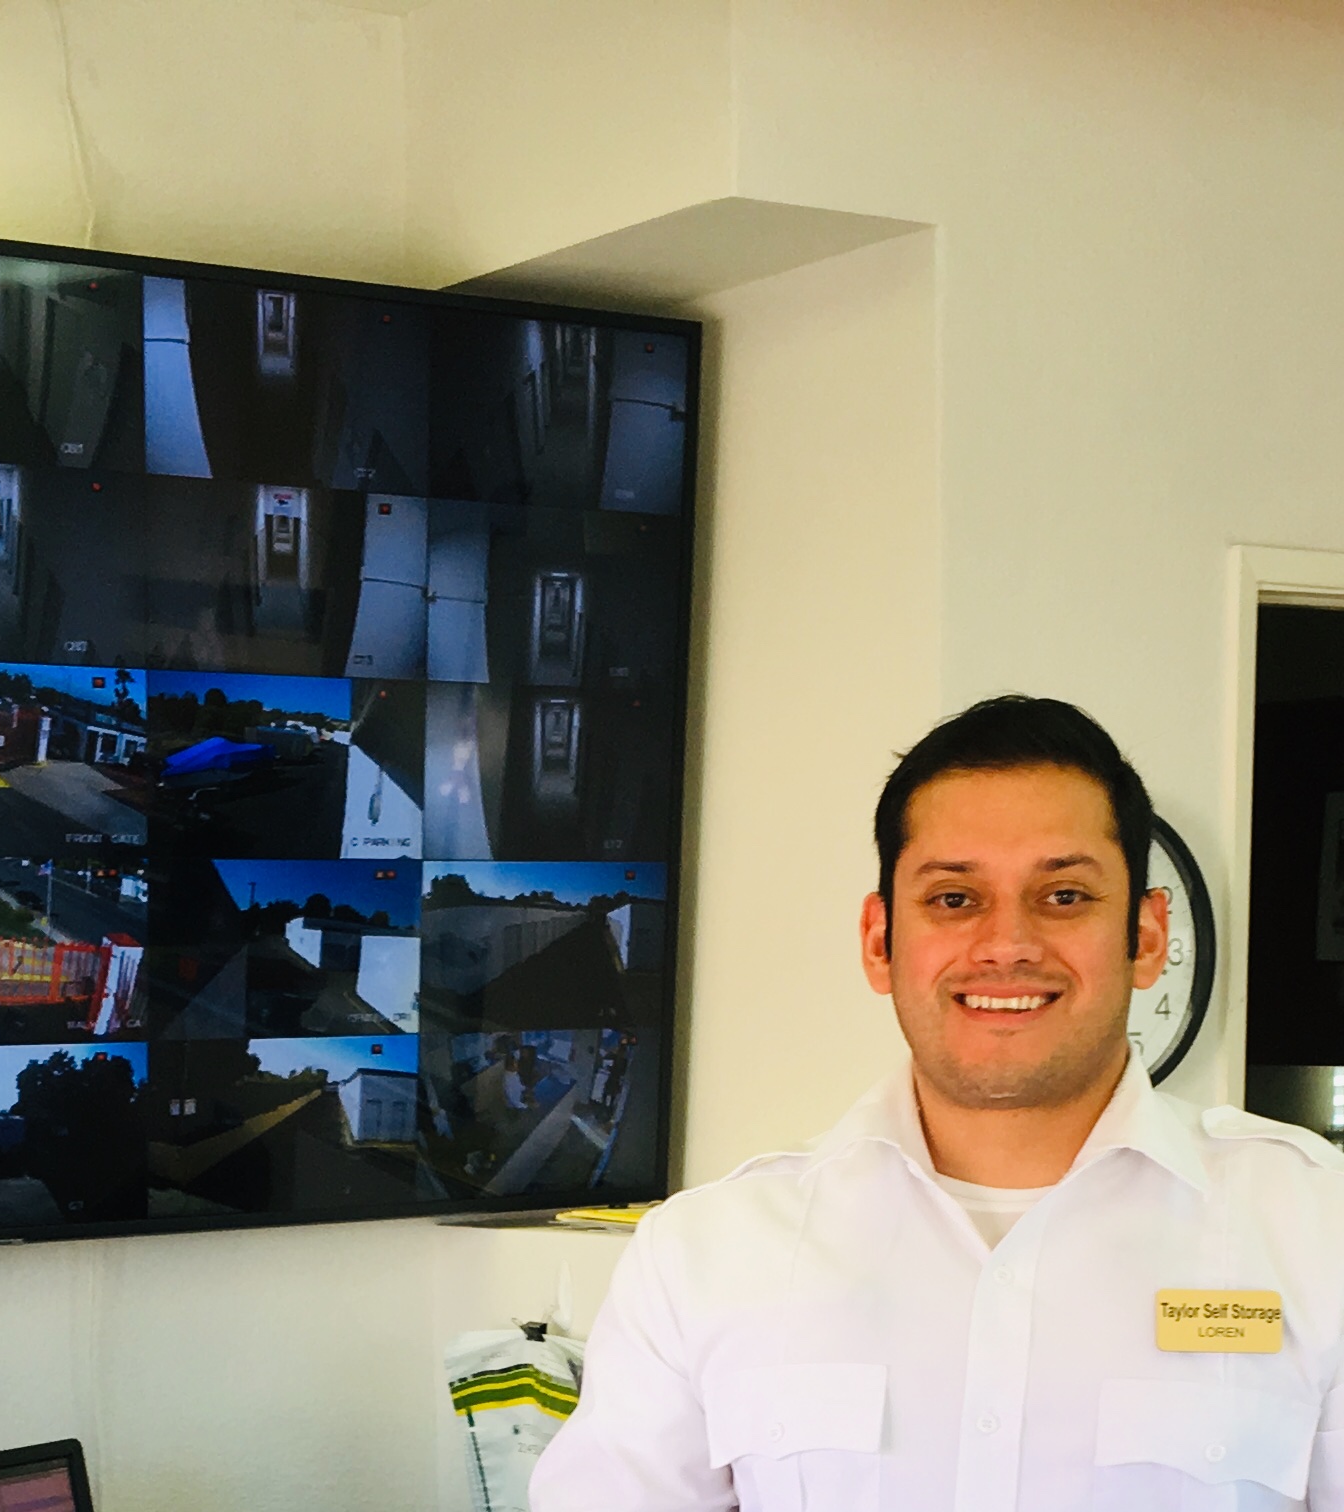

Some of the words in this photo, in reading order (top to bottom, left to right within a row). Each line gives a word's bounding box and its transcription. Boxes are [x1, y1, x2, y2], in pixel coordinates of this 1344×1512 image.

[362, 837, 412, 848] PARKNG
[1167, 938, 1184, 967] 3
[1154, 993, 1172, 1020] 4
[1161, 1302, 1200, 1322] Taylor
[1203, 1303, 1229, 1319] Self
[1231, 1304, 1281, 1323] Storage
[1197, 1326, 1245, 1338] LOREN
